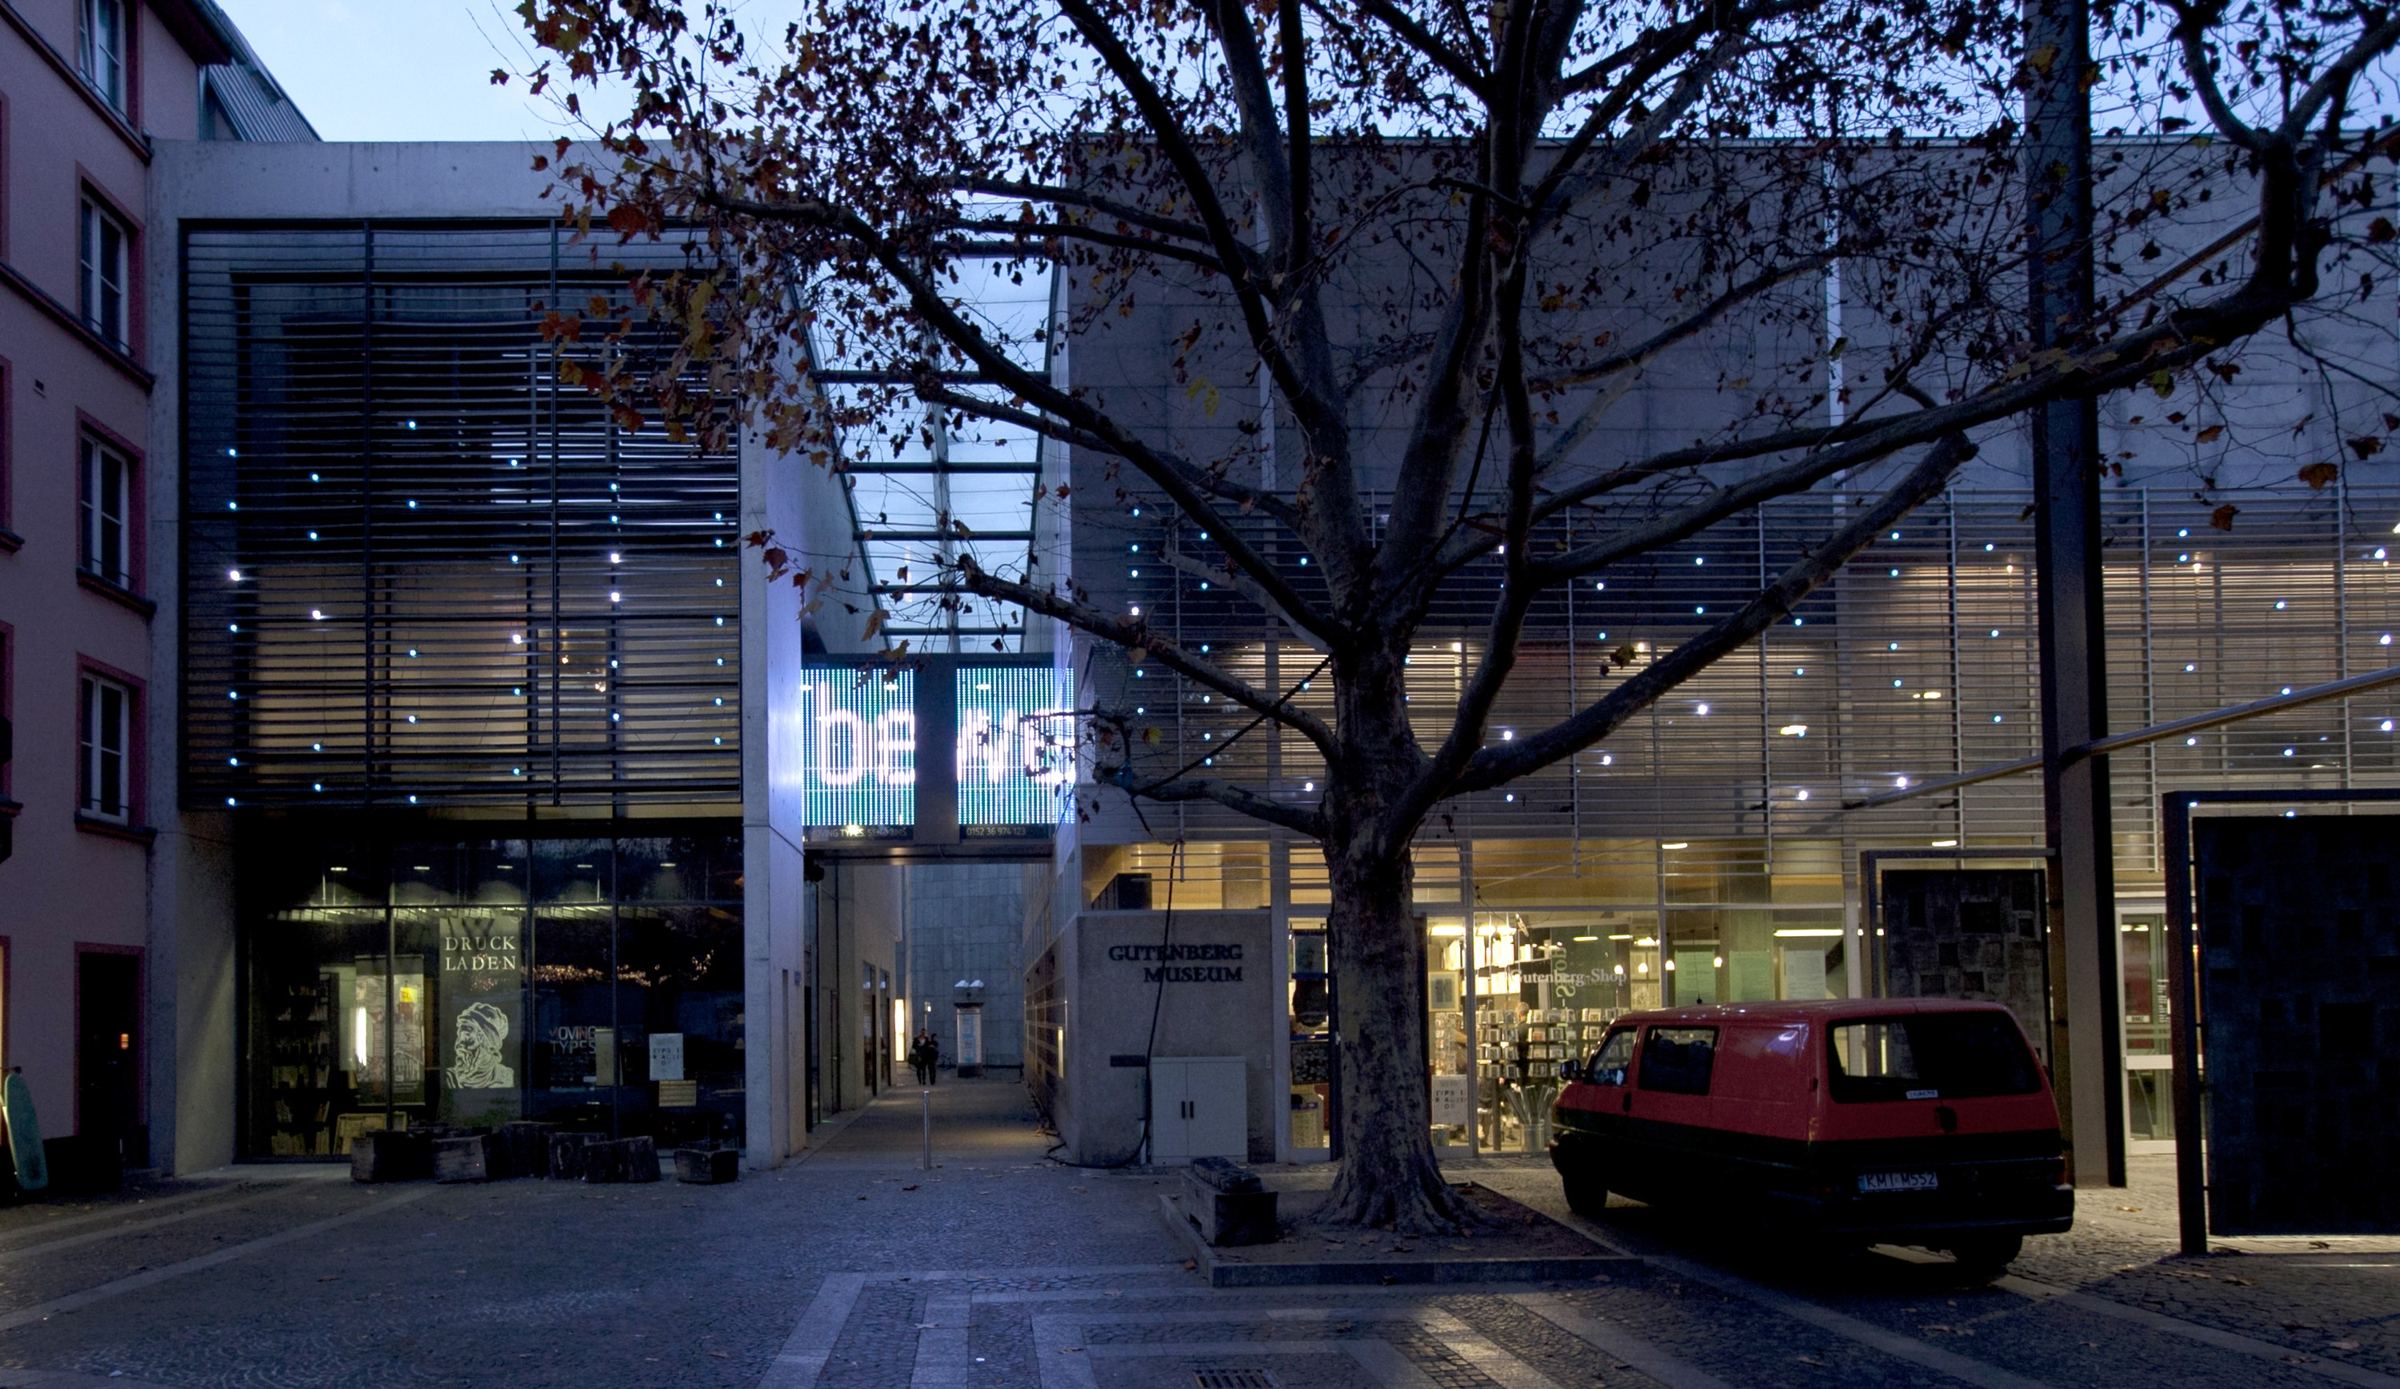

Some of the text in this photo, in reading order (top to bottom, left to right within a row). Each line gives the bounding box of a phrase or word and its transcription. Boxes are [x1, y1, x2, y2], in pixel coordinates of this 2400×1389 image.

[445, 936, 516, 951] DRUCK
[1108, 944, 1243, 961] GUTENBERG
[445, 956, 516, 971] LADEN
[1143, 966, 1243, 982] MUSEUM
